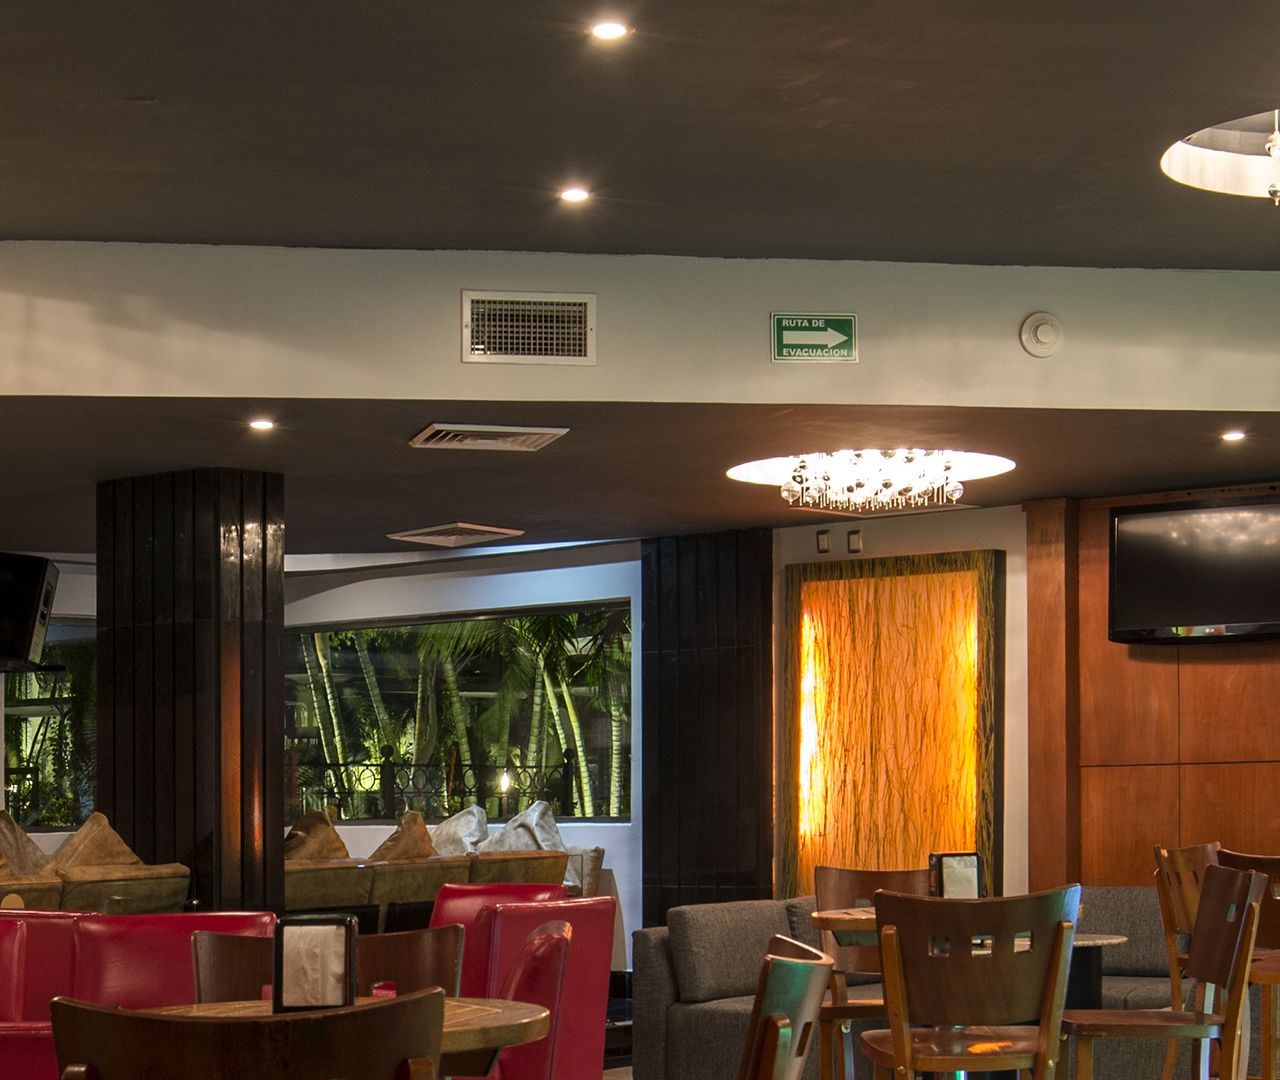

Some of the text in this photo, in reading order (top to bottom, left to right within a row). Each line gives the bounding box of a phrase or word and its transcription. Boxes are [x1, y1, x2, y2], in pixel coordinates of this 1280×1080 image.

[782, 319, 825, 327] RUTA DE
[783, 348, 848, 357] EVACUACION
